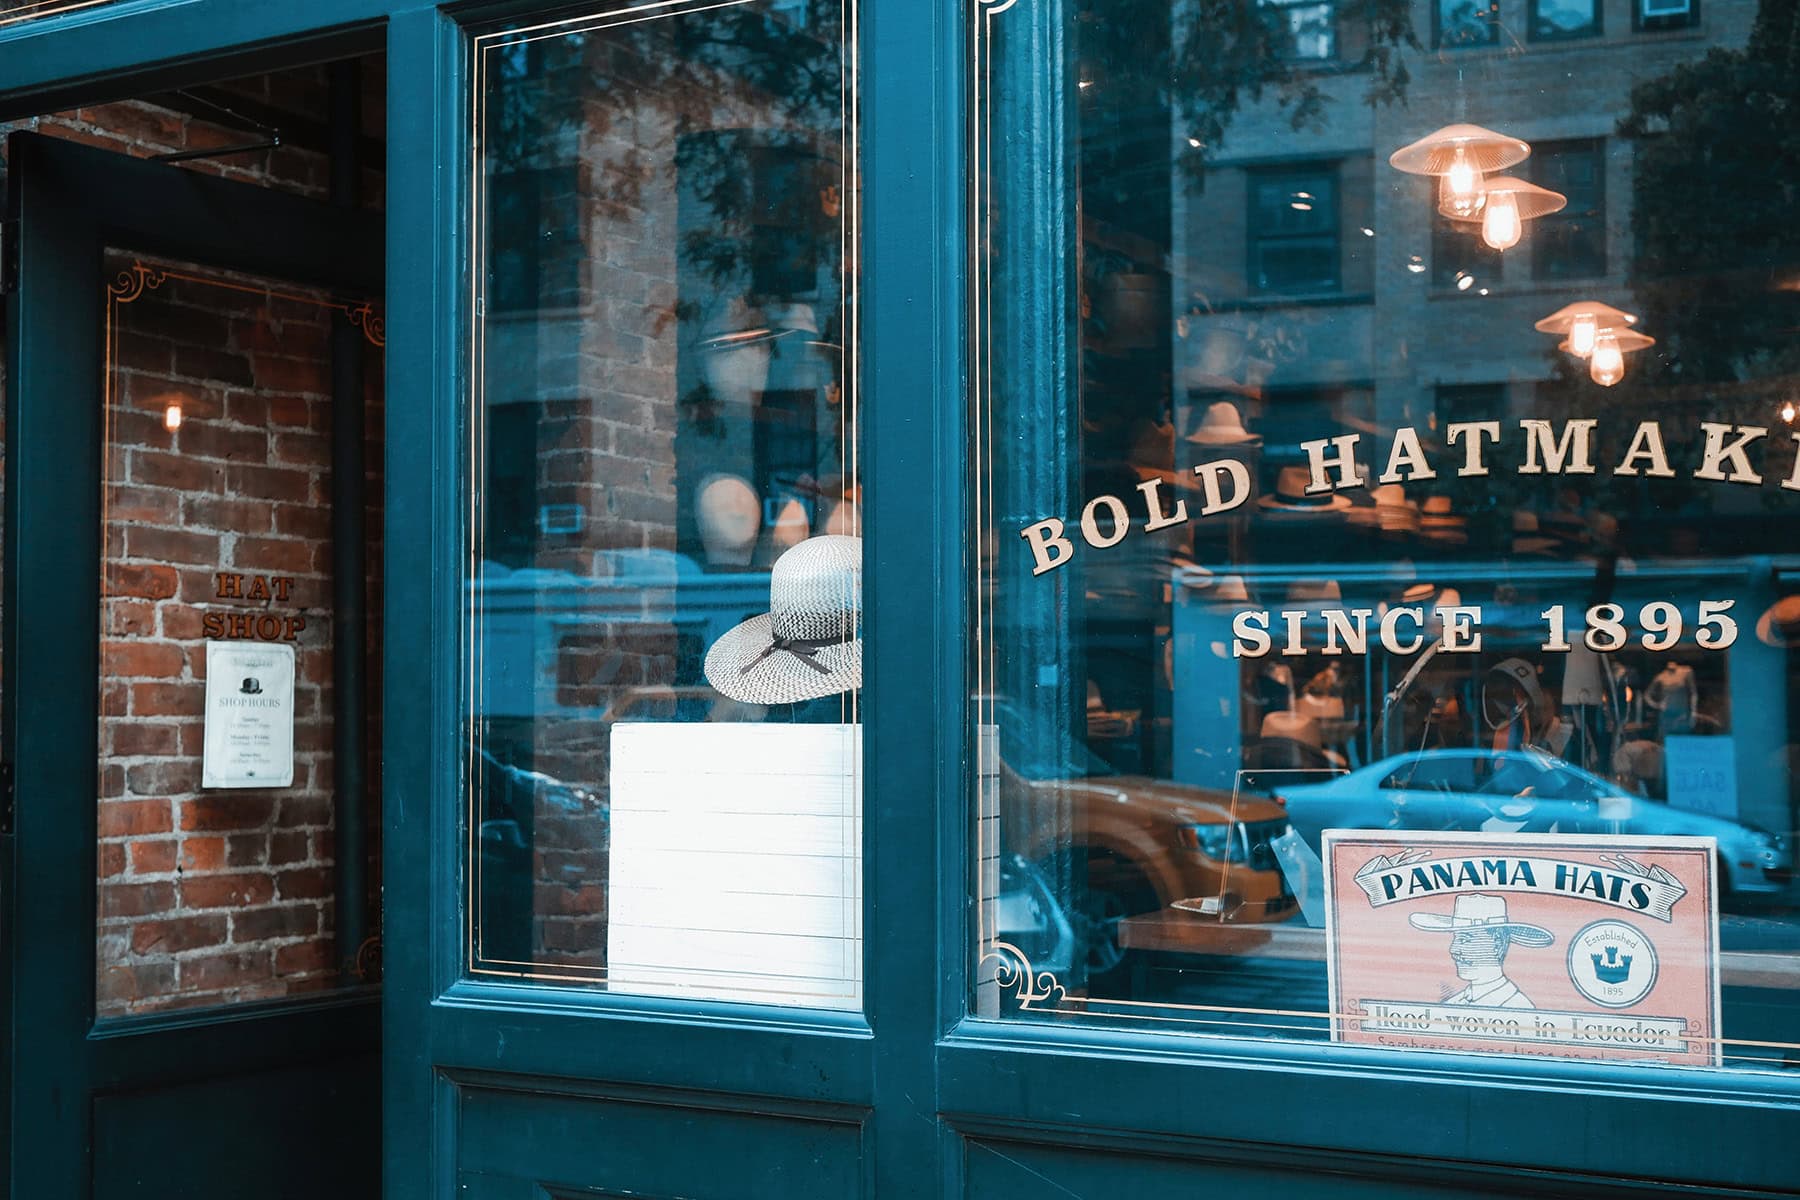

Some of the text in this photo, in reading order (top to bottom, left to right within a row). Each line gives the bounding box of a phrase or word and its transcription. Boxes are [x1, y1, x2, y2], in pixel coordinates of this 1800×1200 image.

[1019, 457, 1252, 577] BOLD
[216, 572, 294, 602] HAT
[202, 612, 306, 641] SHOP
[1231, 599, 1739, 659] SINCE 1895
[219, 697, 281, 709] SHOP HOURS
[1380, 859, 1653, 910] PANAMA HATS
[1583, 929, 1638, 949] Established
[1602, 986, 1624, 997] 1895
[1375, 1005, 1671, 1046] Hand-woven in Ecuador
